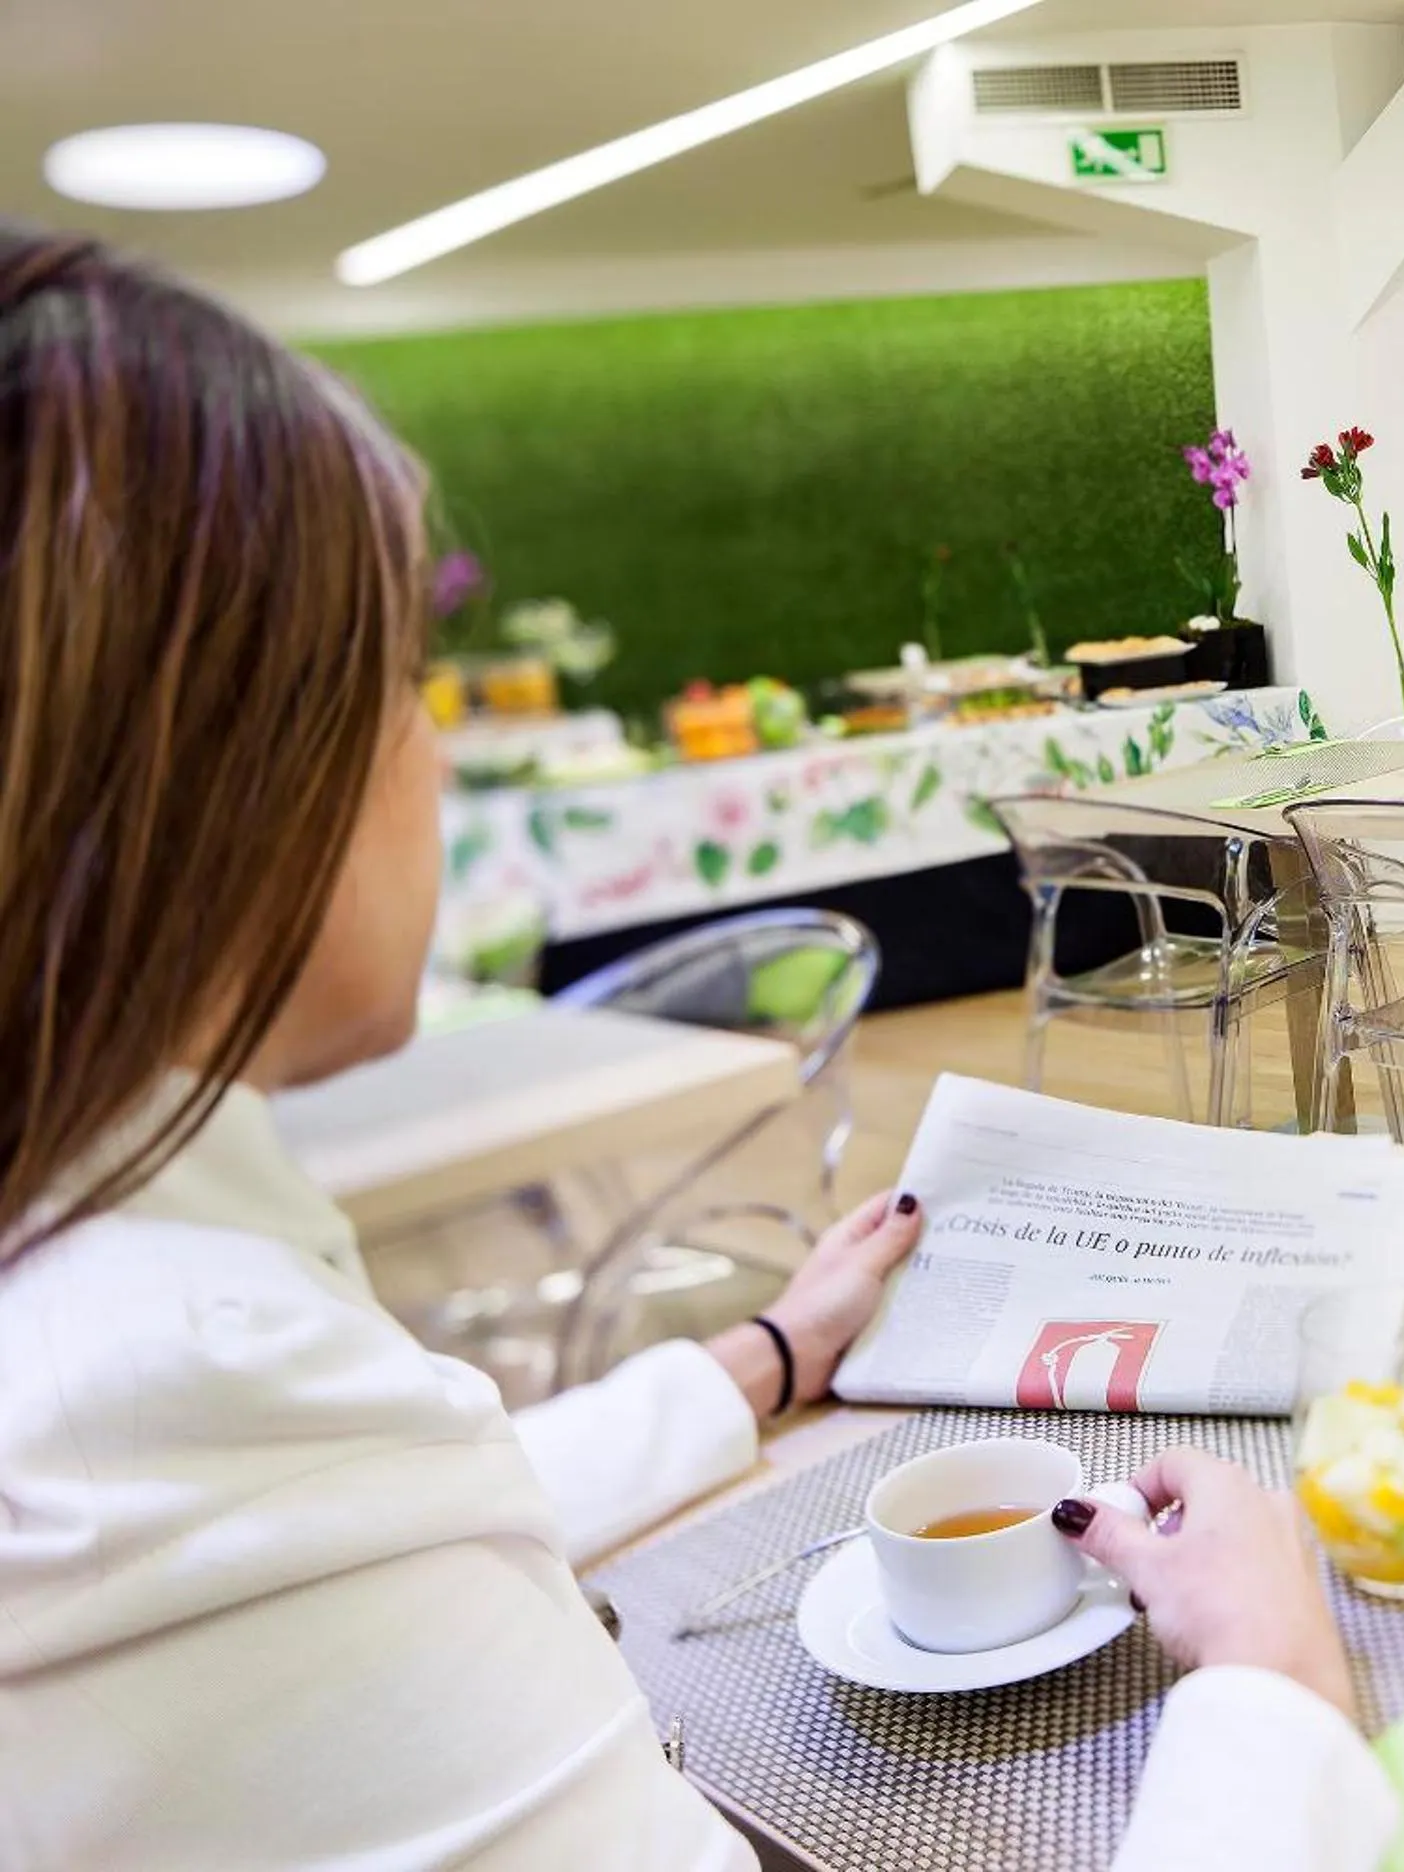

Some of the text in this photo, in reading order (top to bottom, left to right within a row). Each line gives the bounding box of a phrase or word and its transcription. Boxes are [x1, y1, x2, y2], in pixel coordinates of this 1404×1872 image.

[1014, 1222, 1042, 1242] de
[1046, 1225, 1067, 1246] la
[1075, 1230, 1111, 1252] UE
[1115, 1238, 1130, 1254] o
[1133, 1241, 1201, 1260] punto
[1208, 1245, 1235, 1263] de
